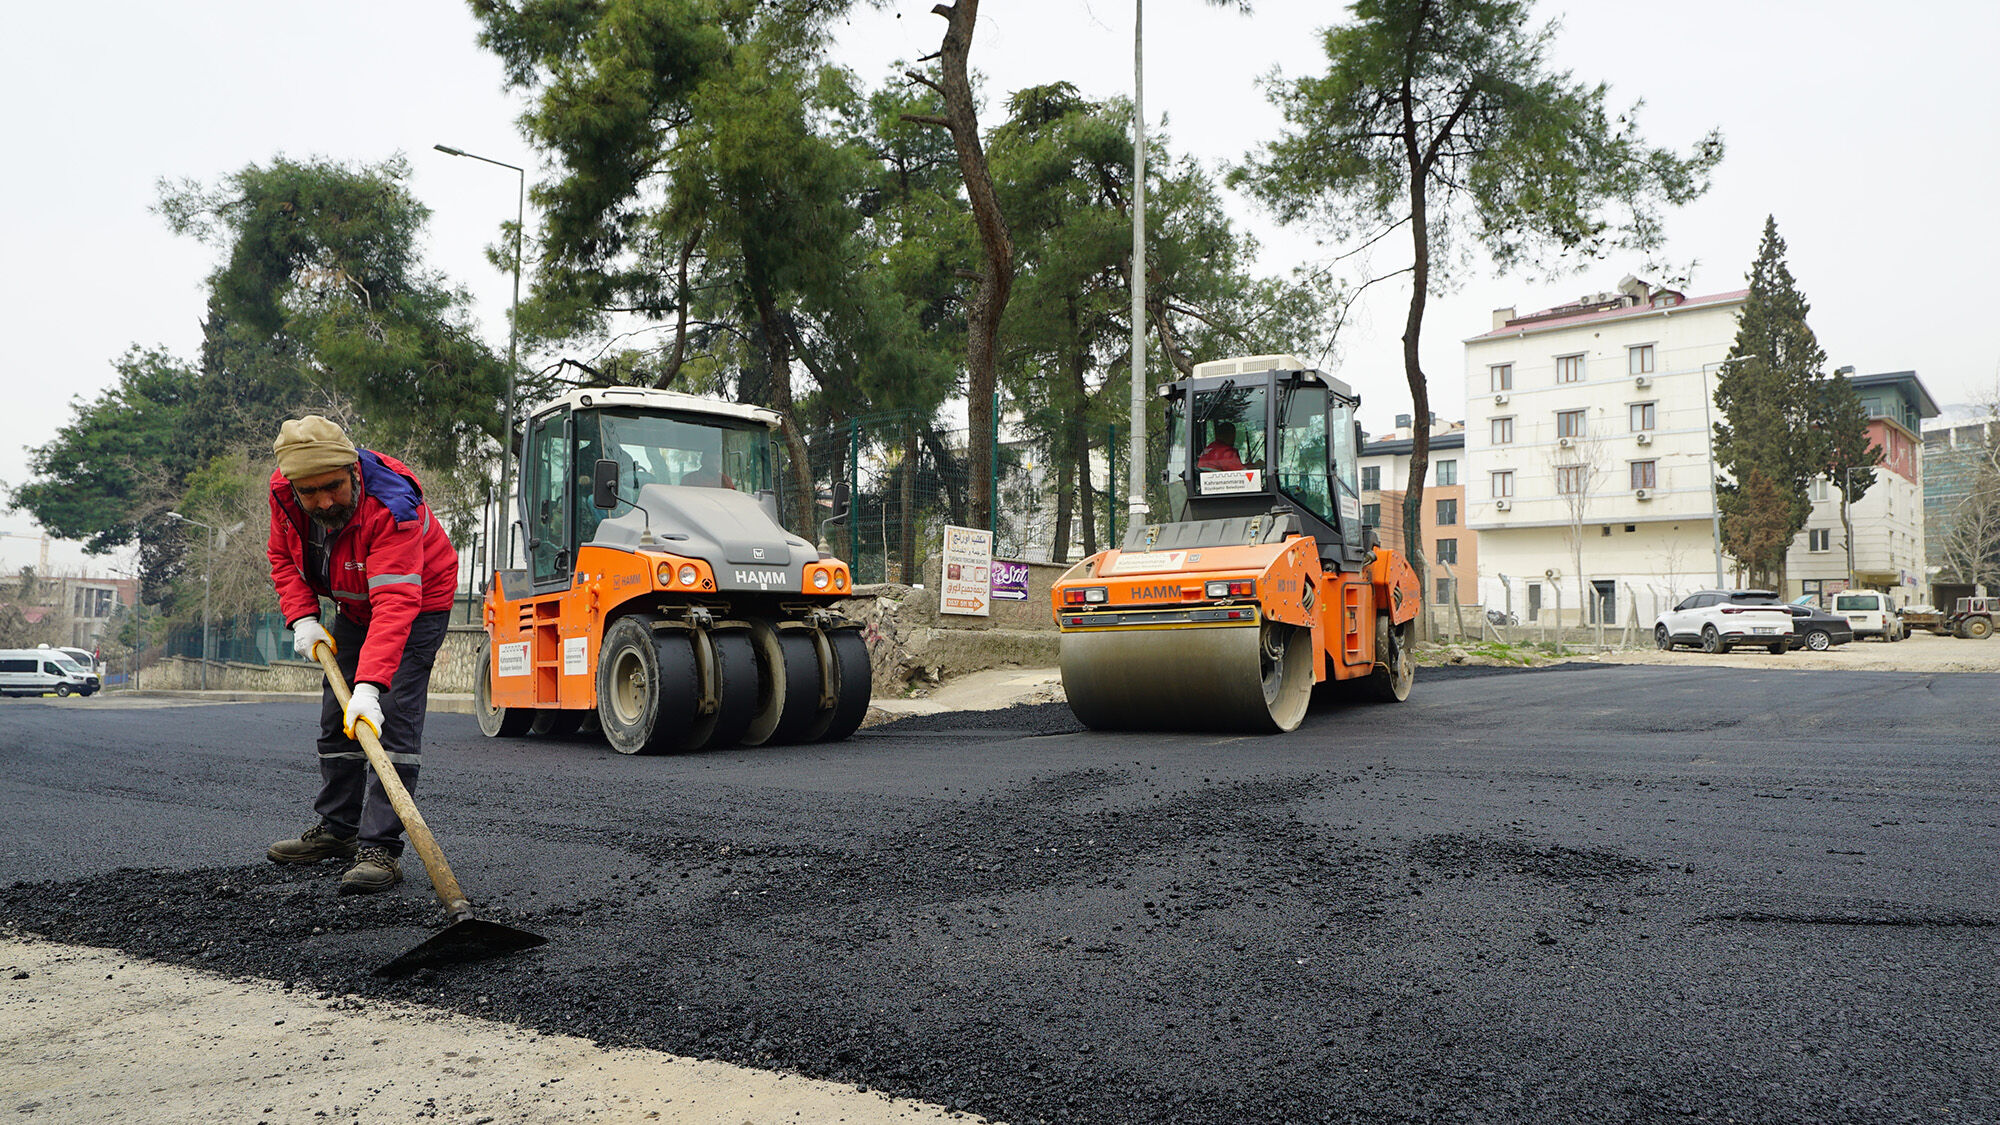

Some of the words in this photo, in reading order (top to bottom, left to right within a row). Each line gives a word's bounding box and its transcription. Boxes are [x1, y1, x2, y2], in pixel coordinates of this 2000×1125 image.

[621, 574, 641, 586] HAMM
[735, 570, 787, 585] HAMM
[1131, 585, 1182, 599] HAMM
